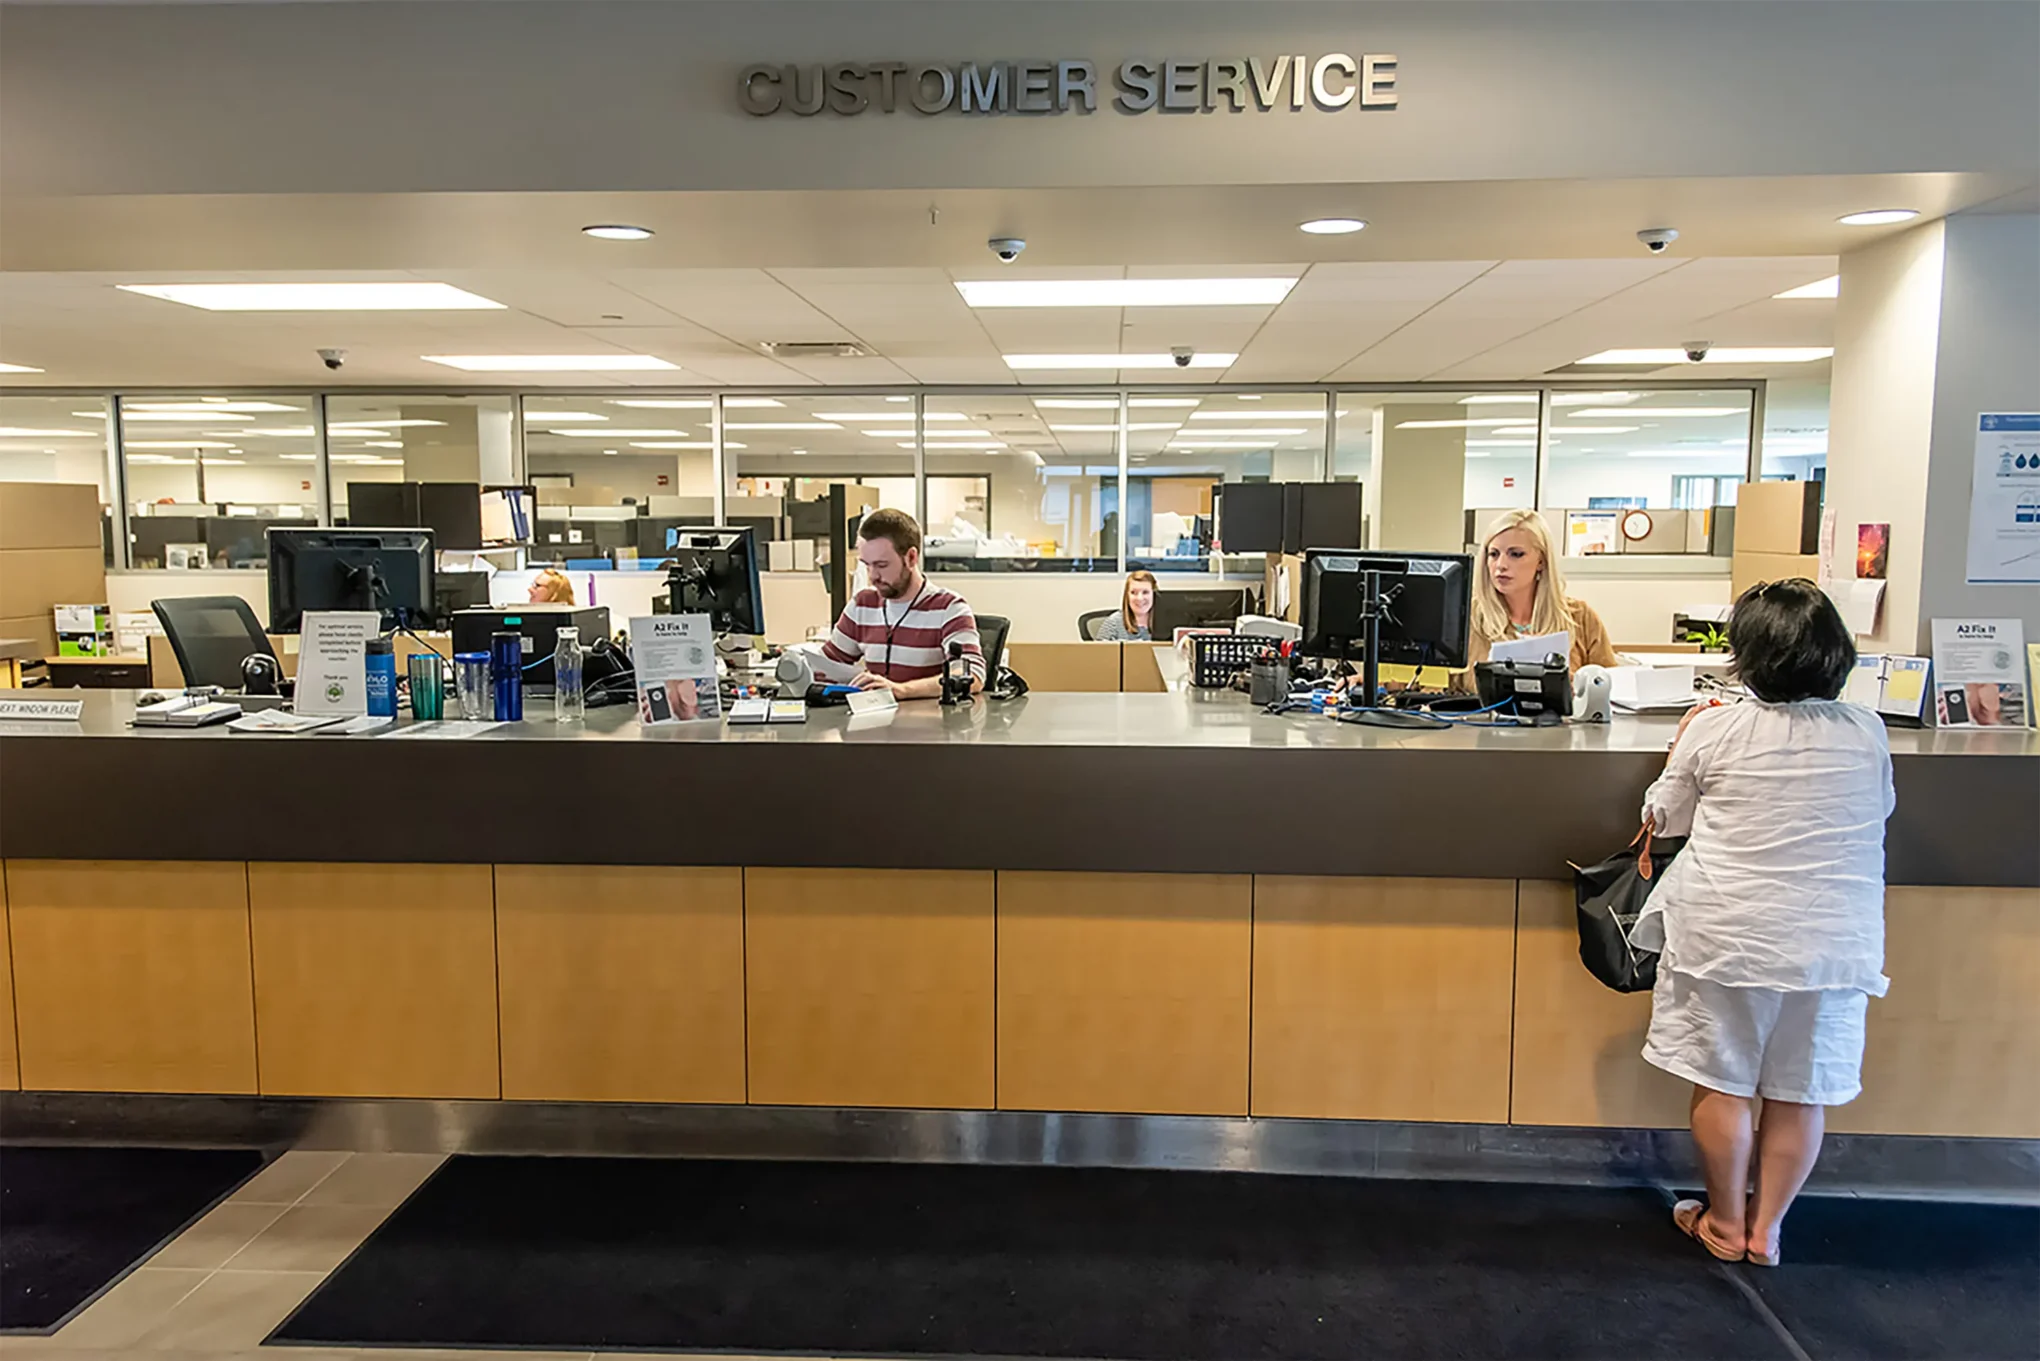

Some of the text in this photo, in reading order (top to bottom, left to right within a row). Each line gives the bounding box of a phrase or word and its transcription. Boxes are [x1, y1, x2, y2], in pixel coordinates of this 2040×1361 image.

[737, 53, 1399, 117] CUSTOMER SERVICE
[654, 623, 666, 632] A2
[1957, 625, 1970, 633] A2
[0, 703, 16, 714] EXT
